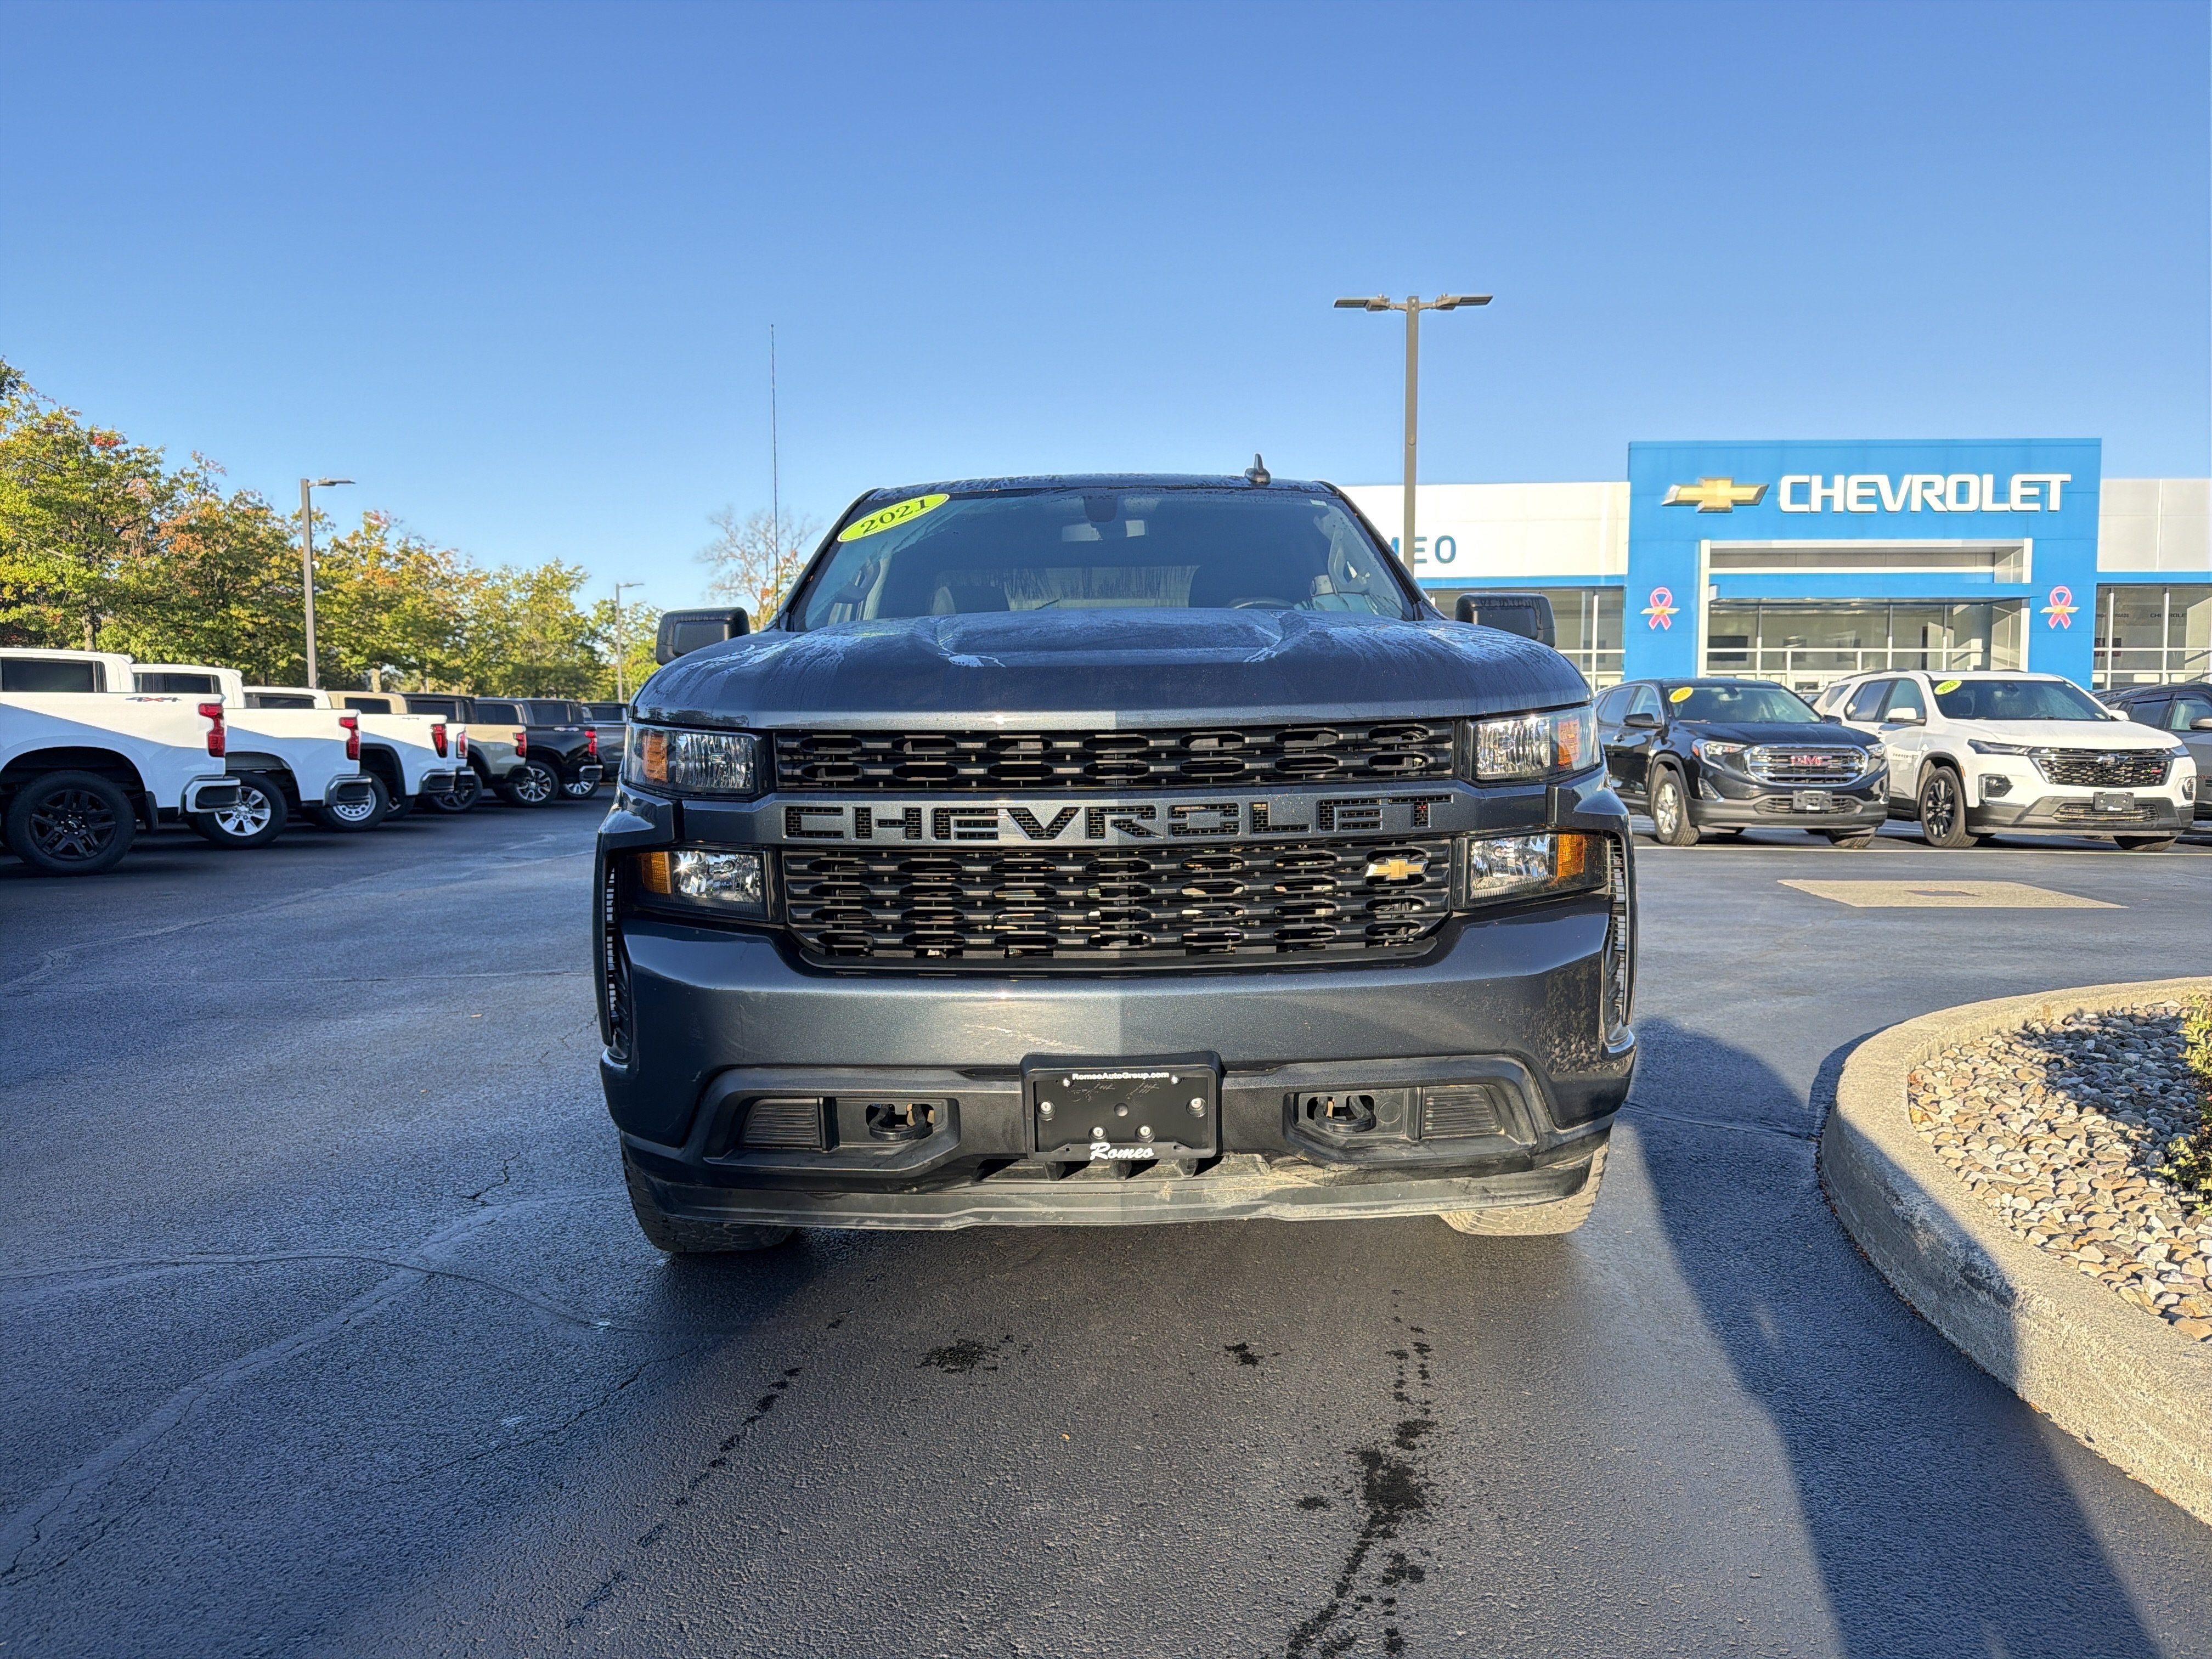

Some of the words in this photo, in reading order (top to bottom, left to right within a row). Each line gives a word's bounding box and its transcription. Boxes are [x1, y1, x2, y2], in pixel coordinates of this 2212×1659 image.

[1779, 474, 2072, 512] CHEVROLET
[860, 499, 930, 534] 2021
[1790, 754, 1832, 766] GMC
[784, 793, 1454, 842] CHEVROLET
[1071, 1071, 1170, 1080] RomeoAutoGroup.com
[1089, 1142, 1155, 1161] Romeo
